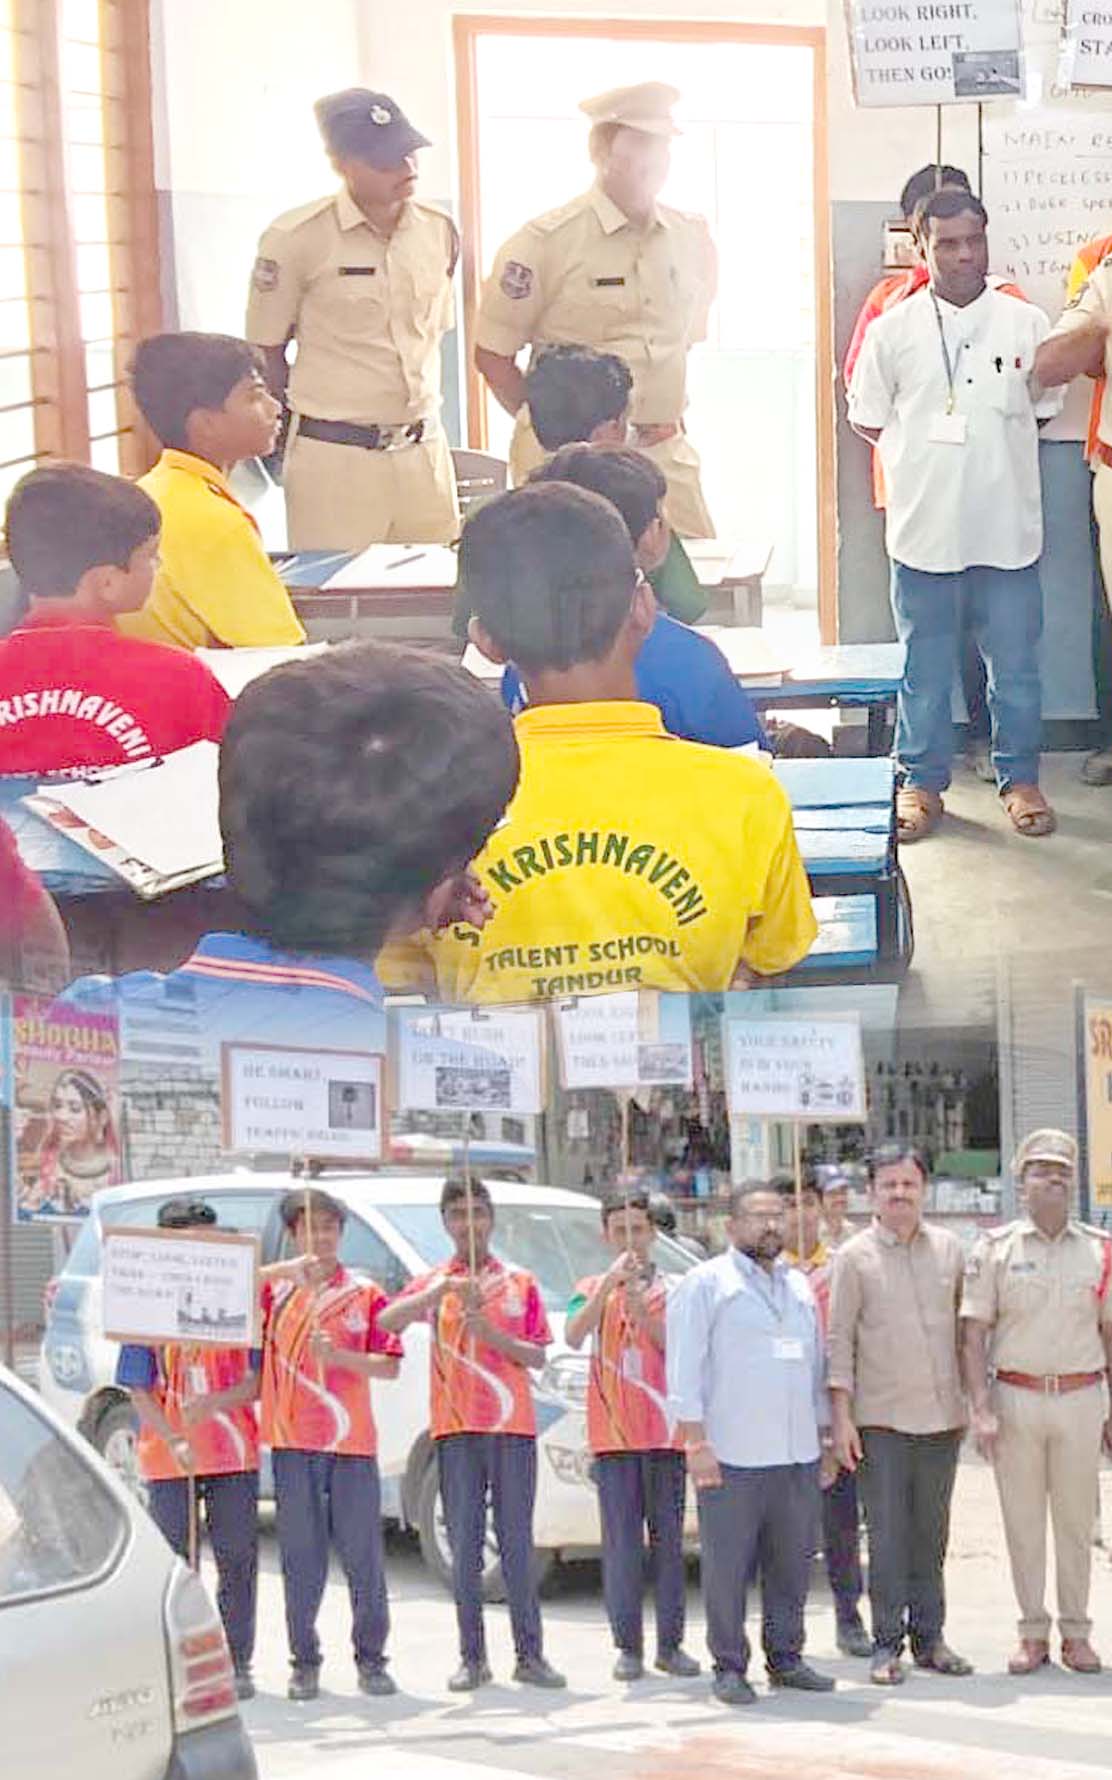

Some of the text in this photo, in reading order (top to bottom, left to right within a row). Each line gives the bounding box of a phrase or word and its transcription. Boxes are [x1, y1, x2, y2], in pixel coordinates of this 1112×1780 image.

[861, 5, 911, 21] LOOK
[865, 37, 912, 52] LOOK
[866, 68, 915, 83] THEN
[0, 689, 152, 758] RISHNAVENI
[487, 832, 707, 927] KRISHNAVENI
[486, 935, 681, 972] TALENT SCHOOL
[531, 966, 643, 997] TANDUR
